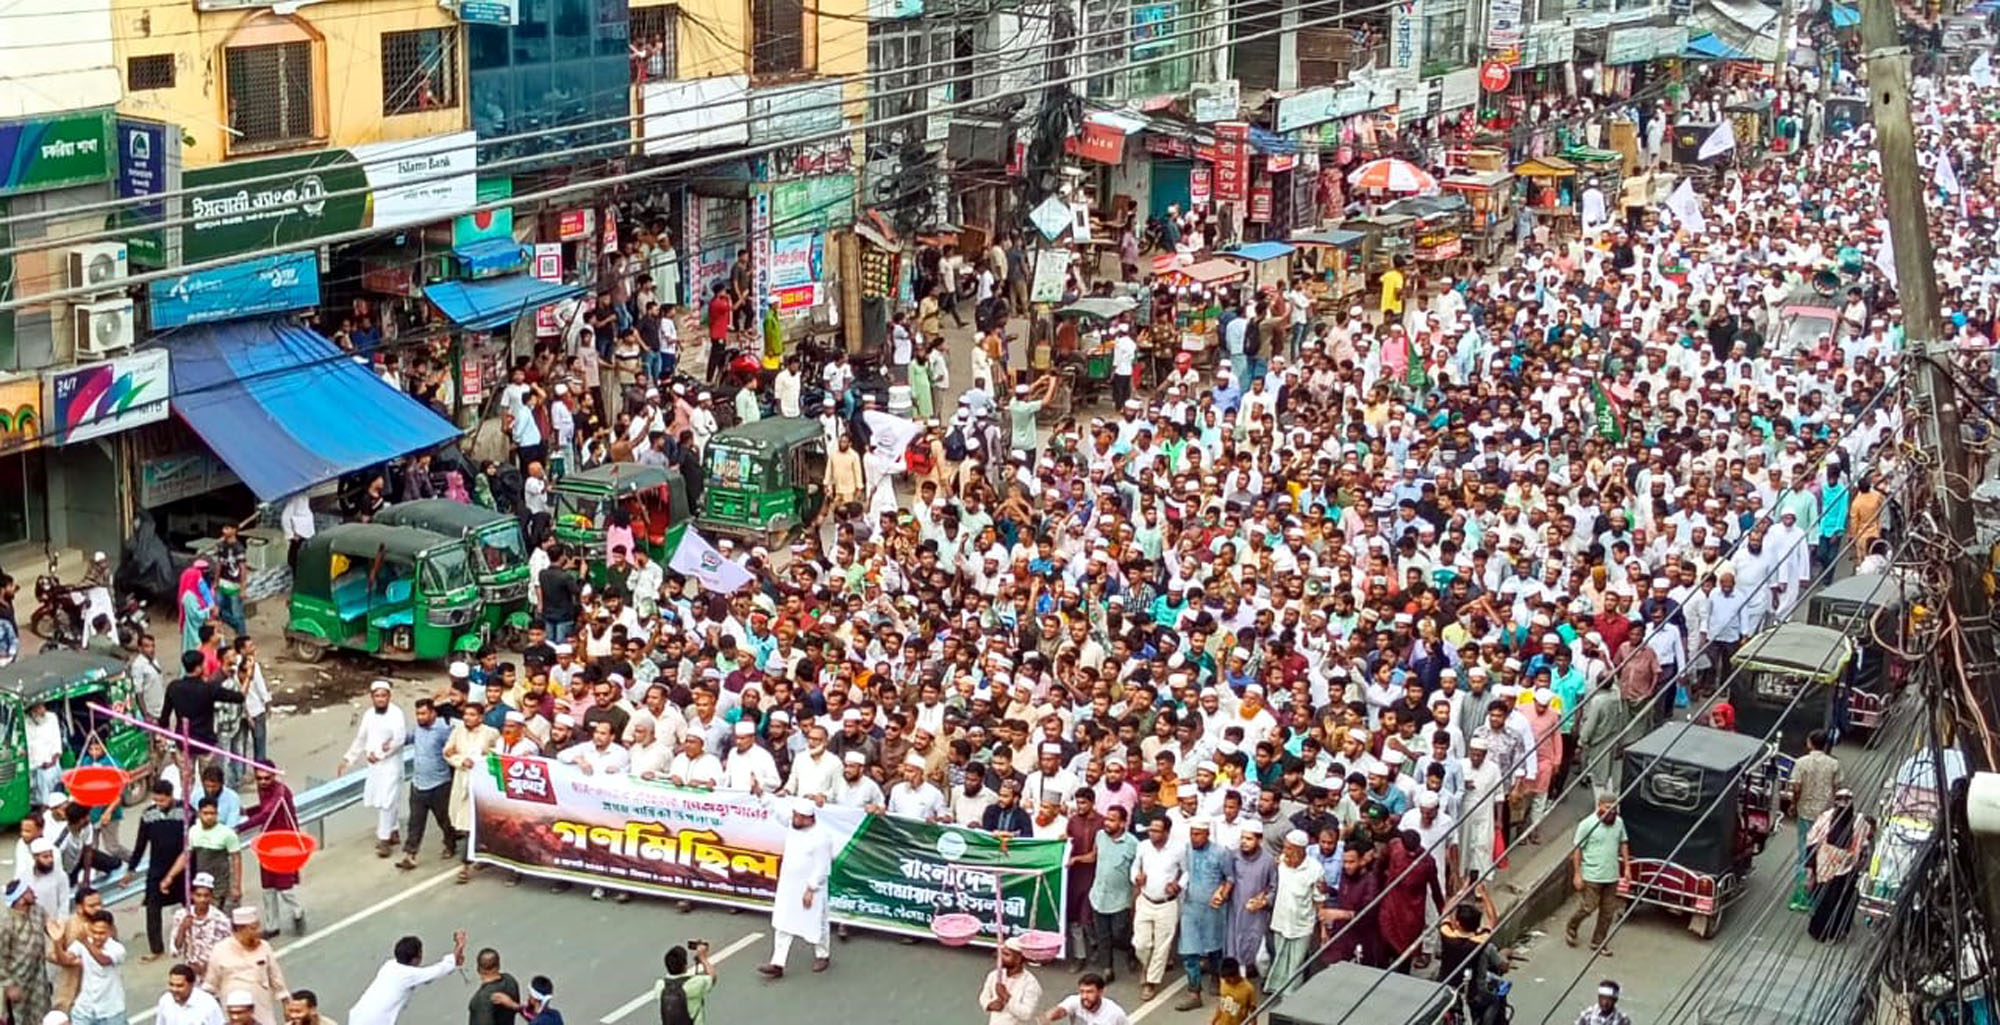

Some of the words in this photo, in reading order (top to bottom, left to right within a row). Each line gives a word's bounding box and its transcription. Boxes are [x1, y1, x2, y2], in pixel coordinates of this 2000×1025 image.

[429, 155, 451, 170] Bank
[192, 190, 249, 219] ইসলামী
[57, 376, 77, 393] 24/7
[508, 761, 542, 779] ৩৬
[508, 777, 547, 797] জুলাই
[551, 820, 781, 881] গণমিছিল
[899, 857, 998, 893] বাংলাদেশ
[868, 879, 954, 910] জামায়াতে
[956, 891, 1026, 918] ইসলামী
